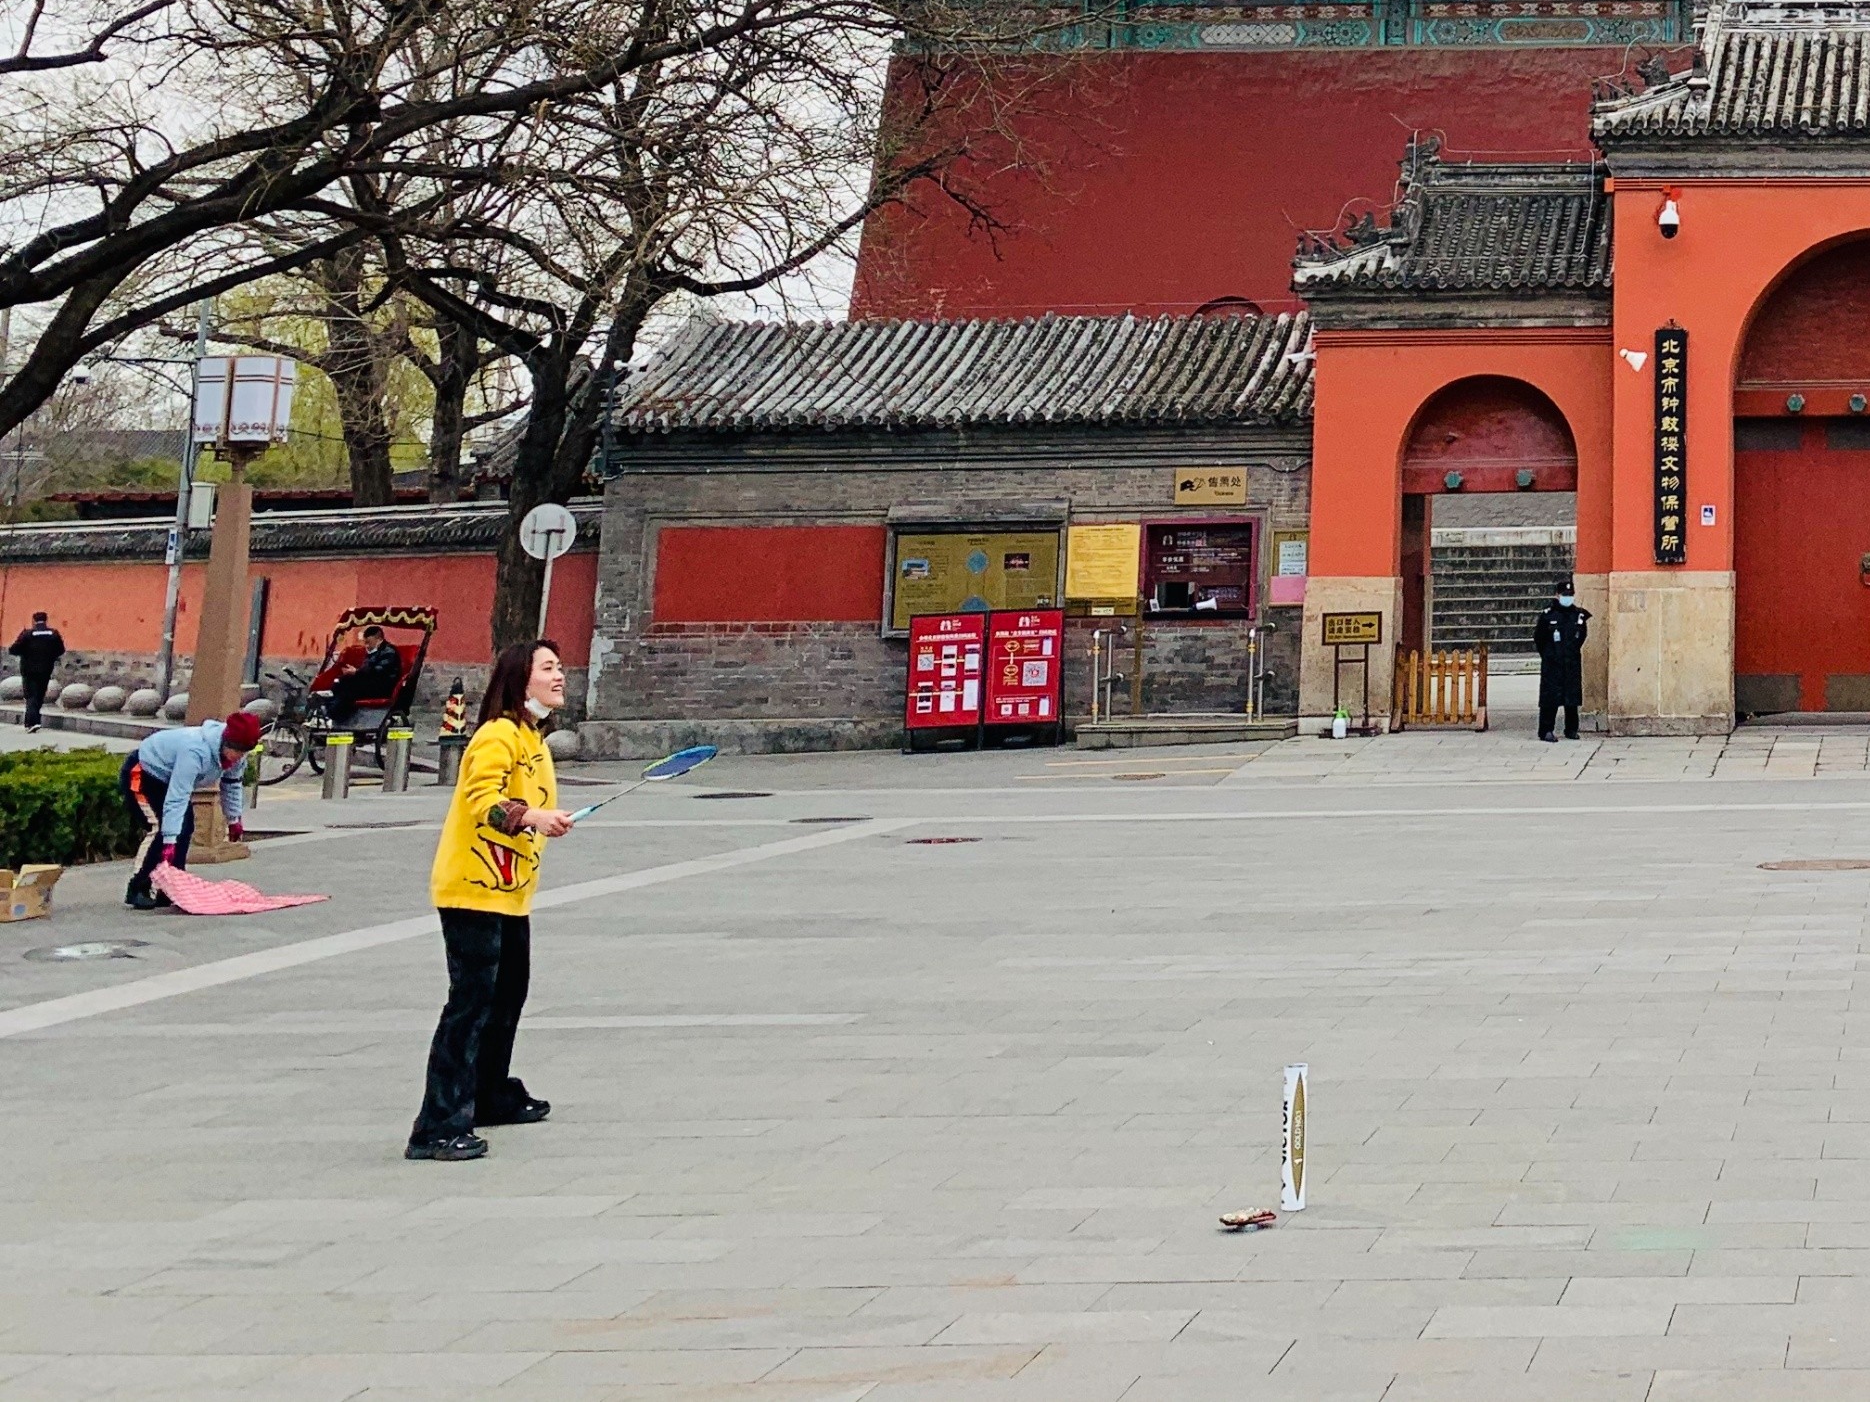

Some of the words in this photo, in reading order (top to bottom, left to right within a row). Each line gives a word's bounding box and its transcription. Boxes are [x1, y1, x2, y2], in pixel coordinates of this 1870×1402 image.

[1208, 476, 1241, 488] 售票处
[1661, 338, 1681, 552] 北京市钟鼓楼文物保管所
